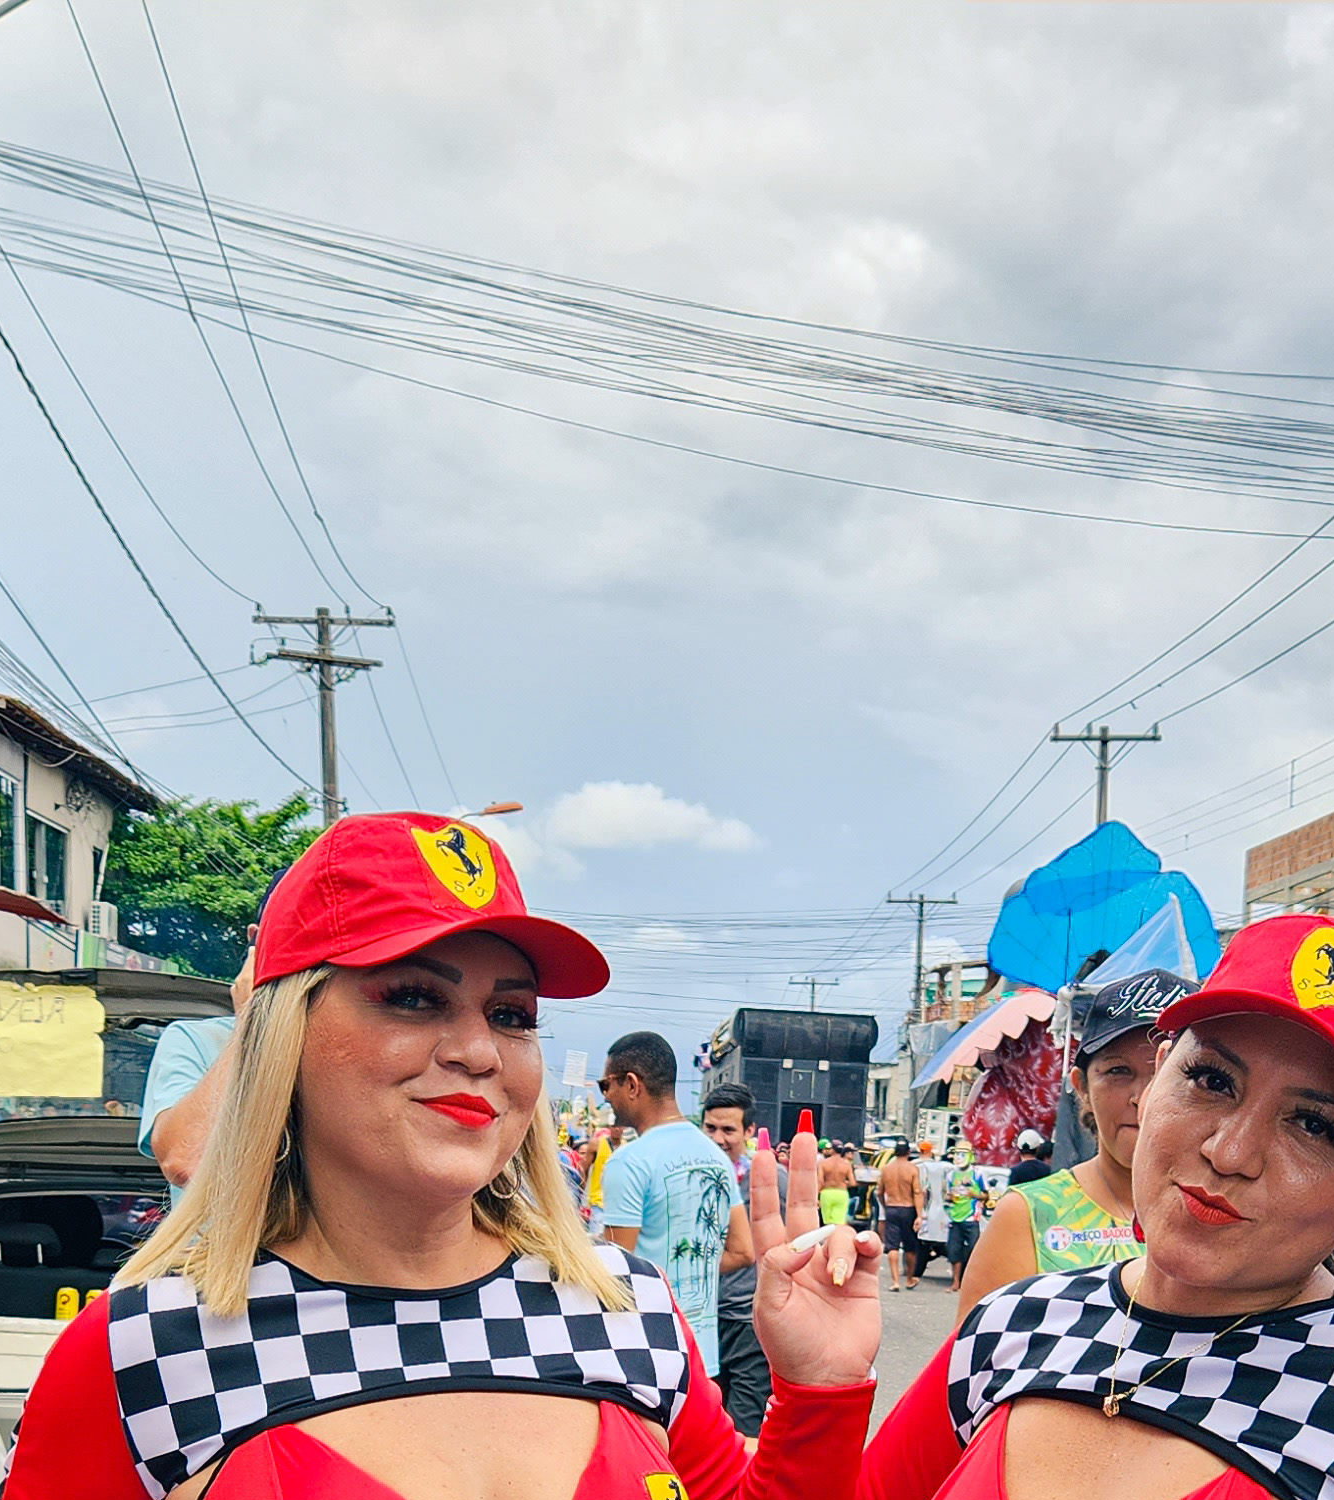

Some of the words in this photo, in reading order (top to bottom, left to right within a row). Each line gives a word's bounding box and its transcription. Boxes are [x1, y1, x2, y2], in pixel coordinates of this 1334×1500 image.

[453, 879, 466, 894] S
[1071, 1229, 1101, 1242] PREÇO
[1102, 1227, 1133, 1239] BAIXO
